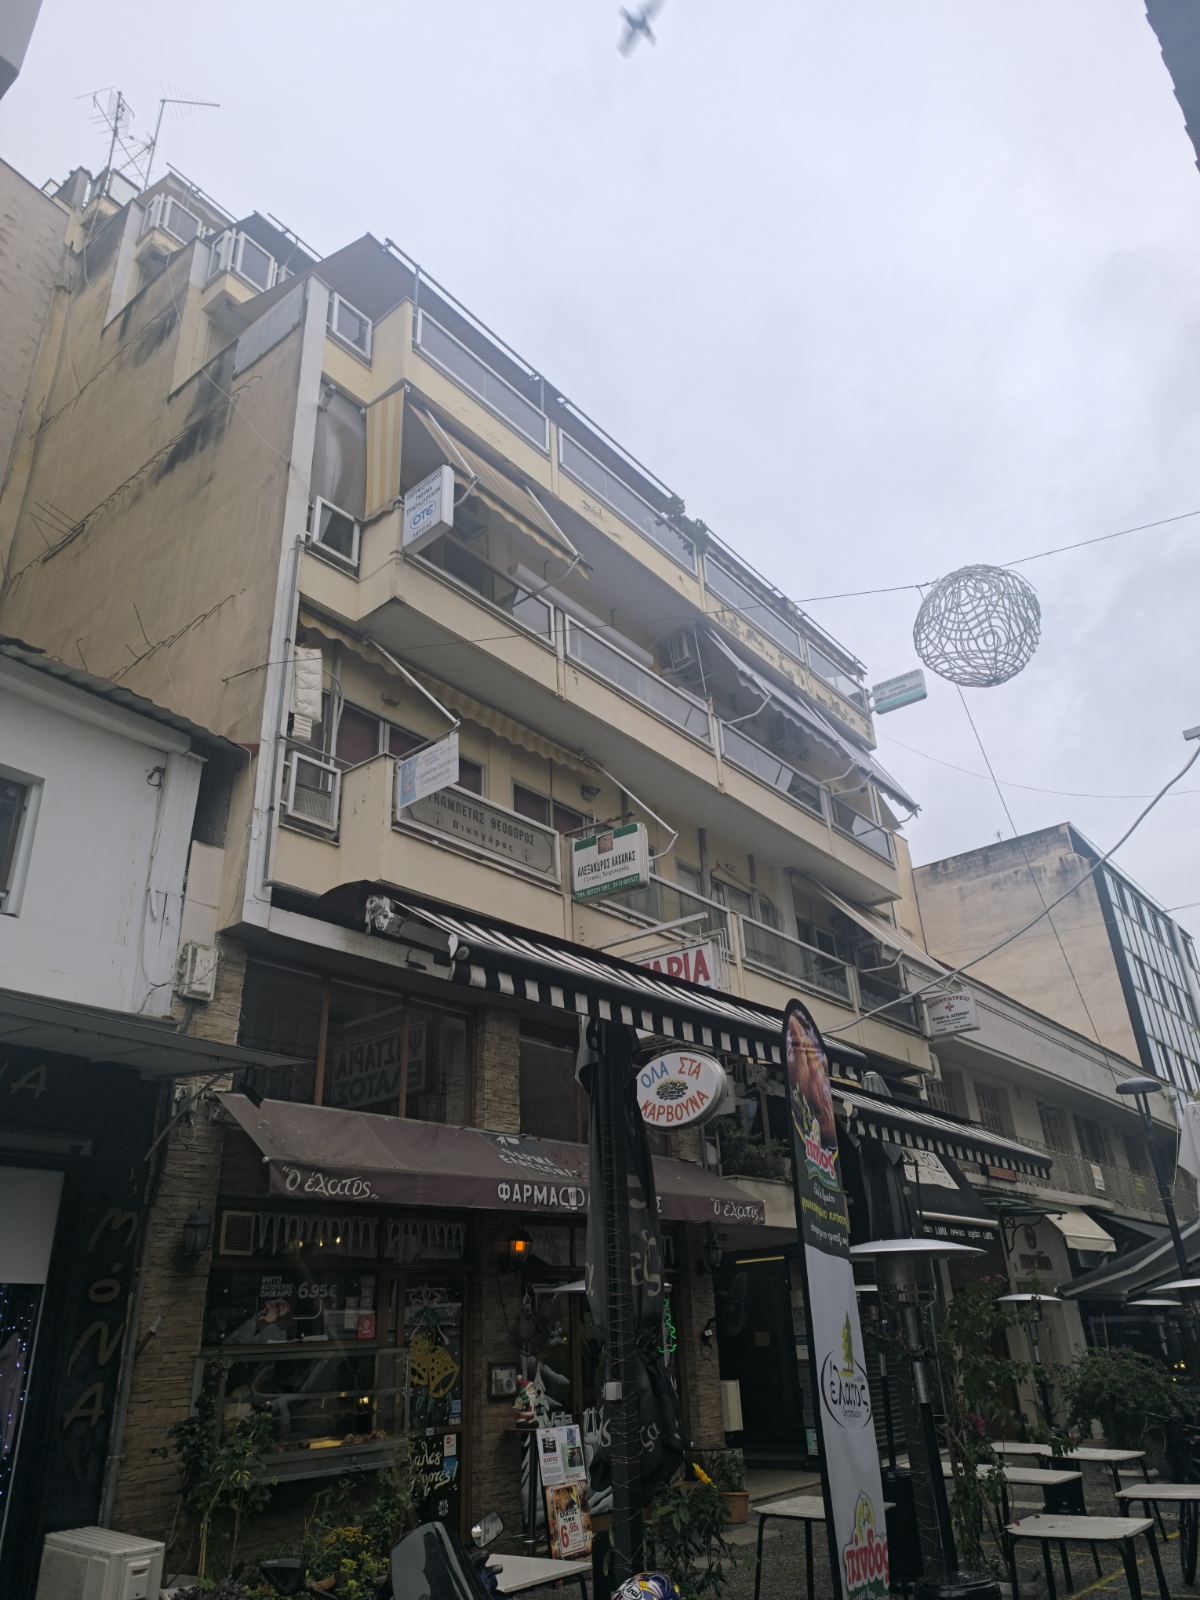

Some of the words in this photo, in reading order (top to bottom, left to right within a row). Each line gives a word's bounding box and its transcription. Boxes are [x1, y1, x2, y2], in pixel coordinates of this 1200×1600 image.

[491, 817, 535, 846] ΘΕΟΔΩΡΟΣ
[577, 857, 611, 877] ΑΛΕΞΑΝΔΡΟΣ
[612, 850, 637, 867] ΛΑΧΑΝΑΣ
[641, 1061, 669, 1089] ΟΛΑ
[678, 1056, 702, 1080] ΣΤΑ
[641, 1089, 709, 1122] ΚΑΡΒΟΥΝΑ
